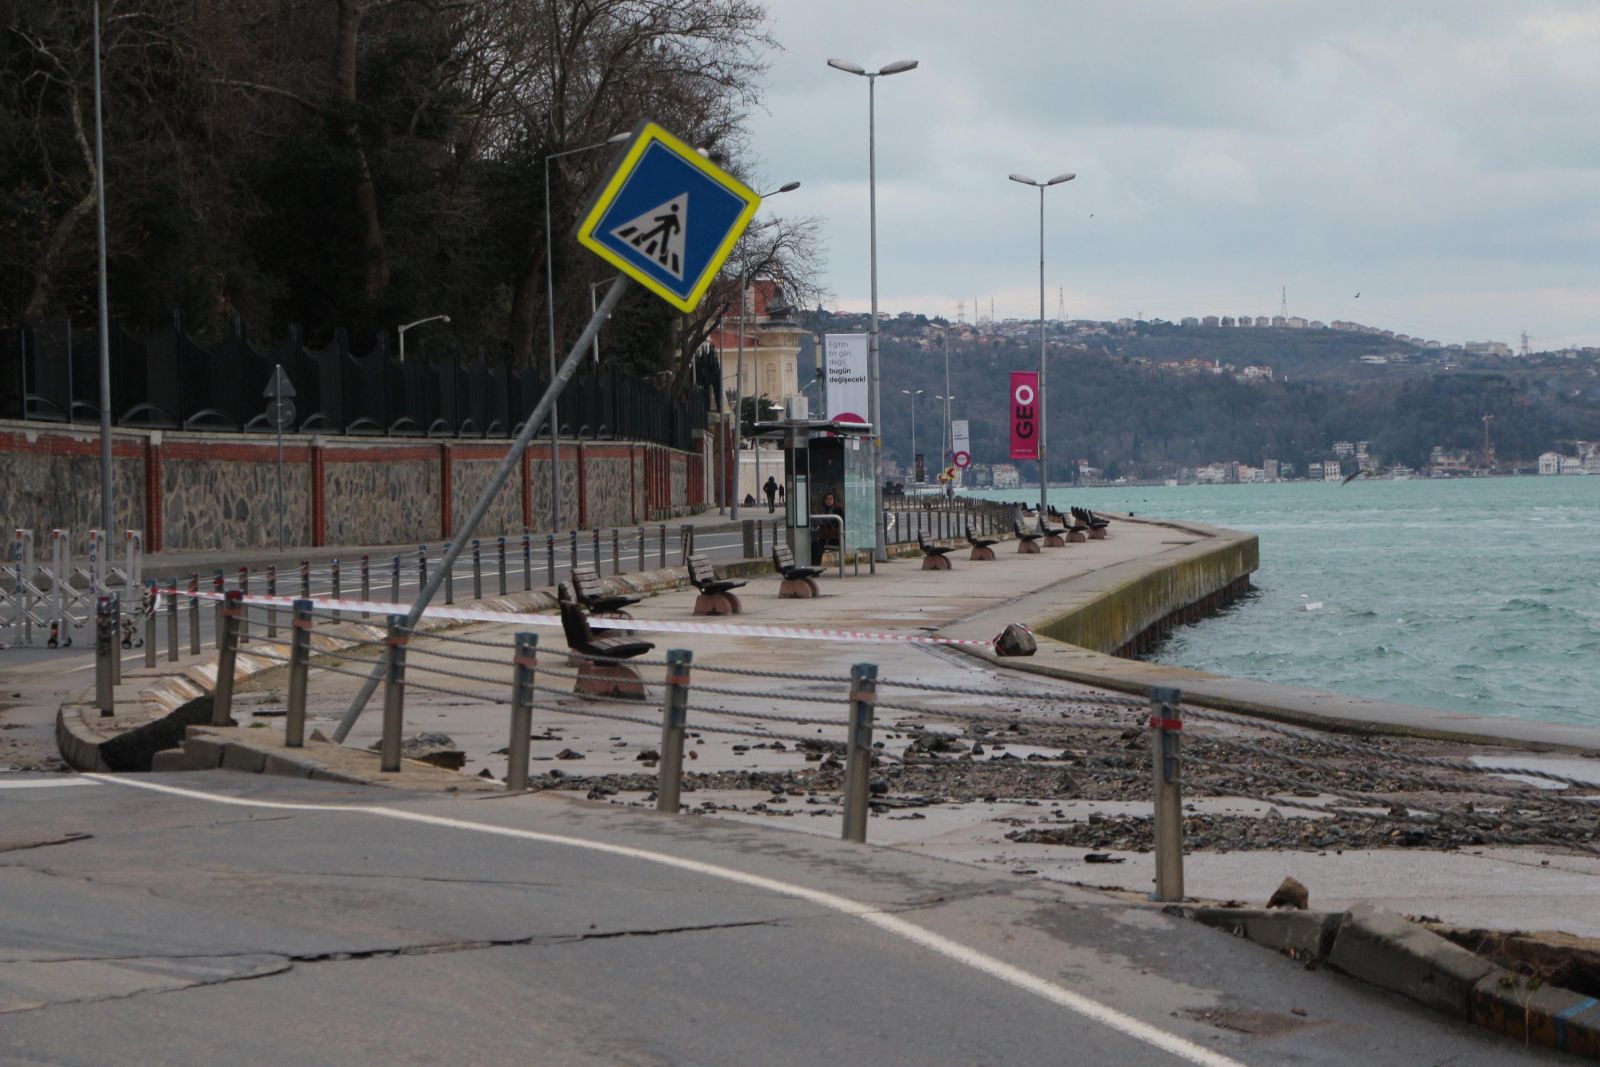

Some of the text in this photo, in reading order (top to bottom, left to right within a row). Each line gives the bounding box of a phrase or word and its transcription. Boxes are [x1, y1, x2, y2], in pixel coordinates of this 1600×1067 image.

[829, 367, 851, 375] bugün
[829, 376, 866, 384] değişecek!
[1015, 385, 1034, 439] GEO
